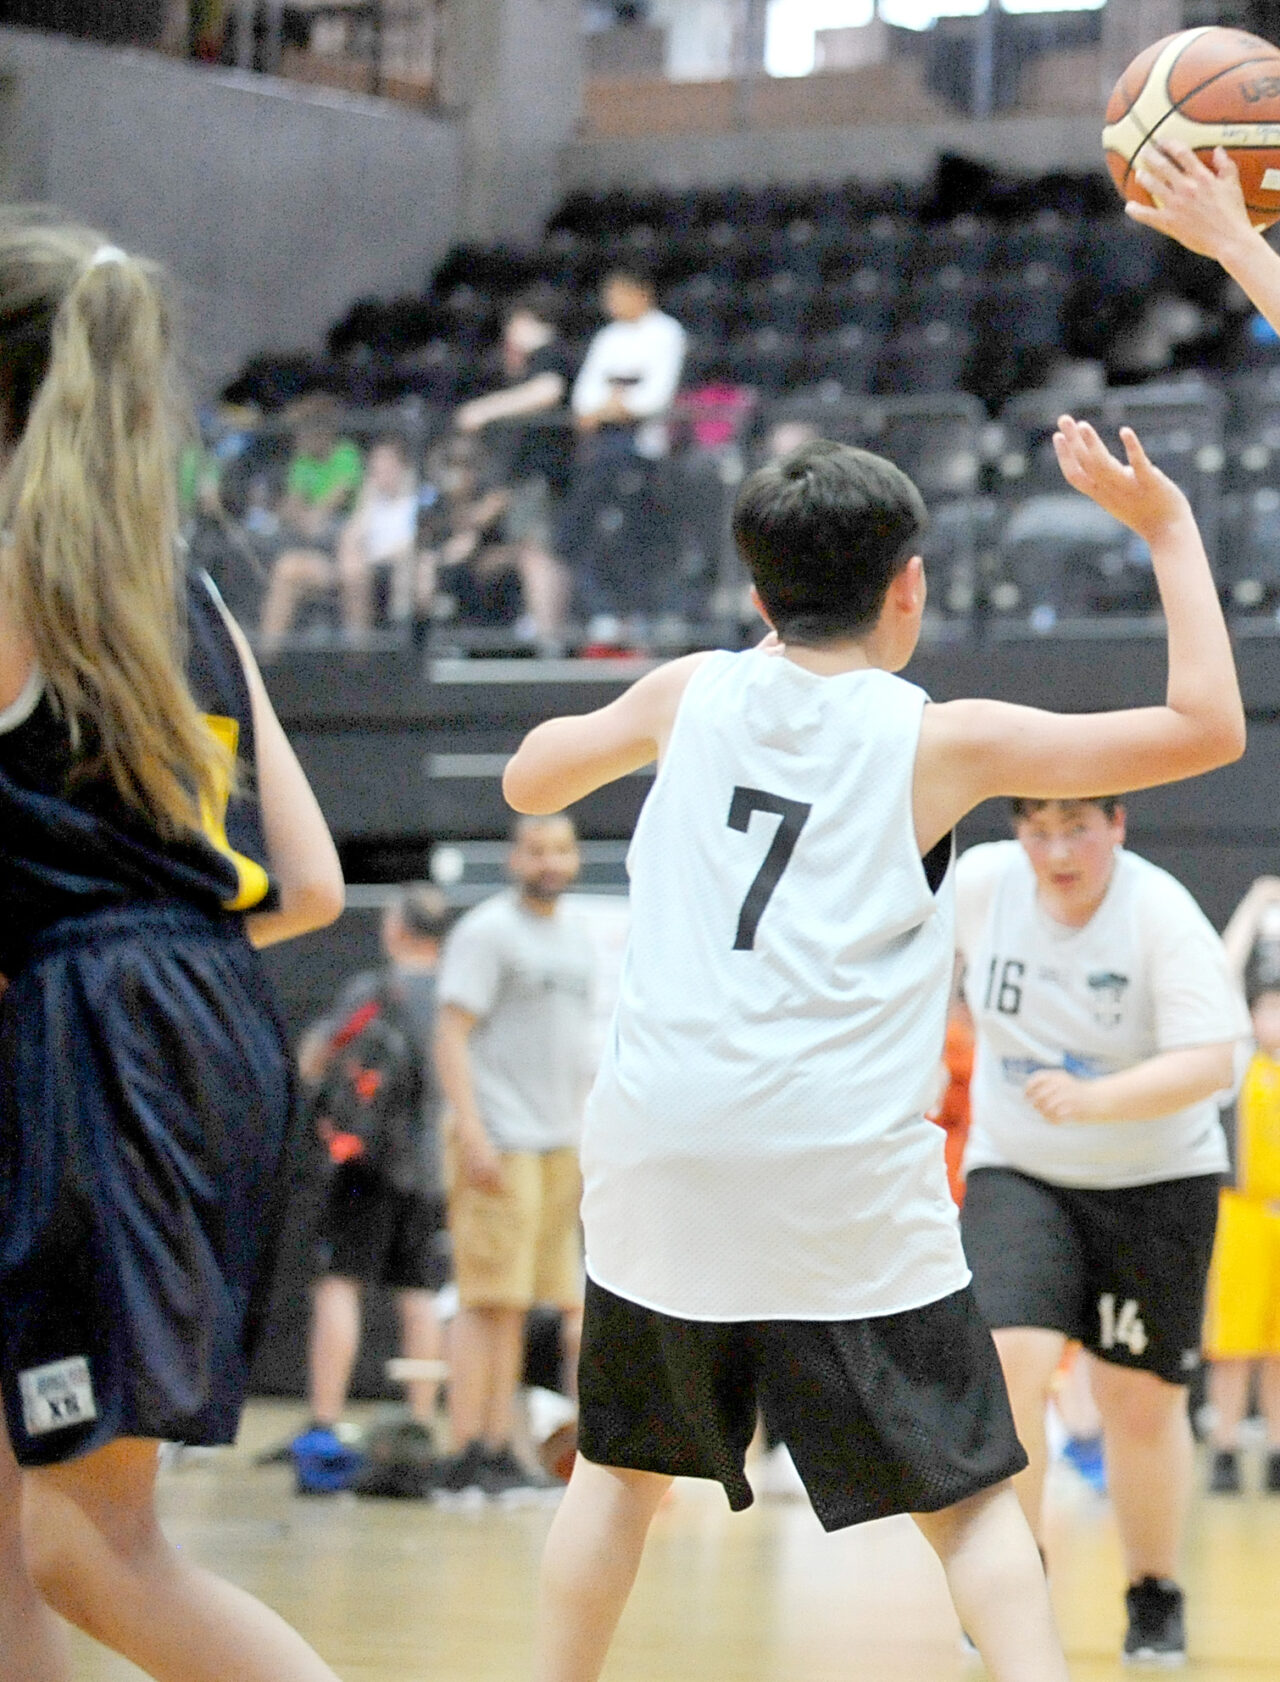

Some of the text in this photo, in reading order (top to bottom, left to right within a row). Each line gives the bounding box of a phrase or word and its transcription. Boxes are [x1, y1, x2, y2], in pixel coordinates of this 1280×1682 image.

[726, 786, 813, 950] 7
[985, 953, 1025, 1015] 16
[1098, 1292, 1149, 1355] 14
